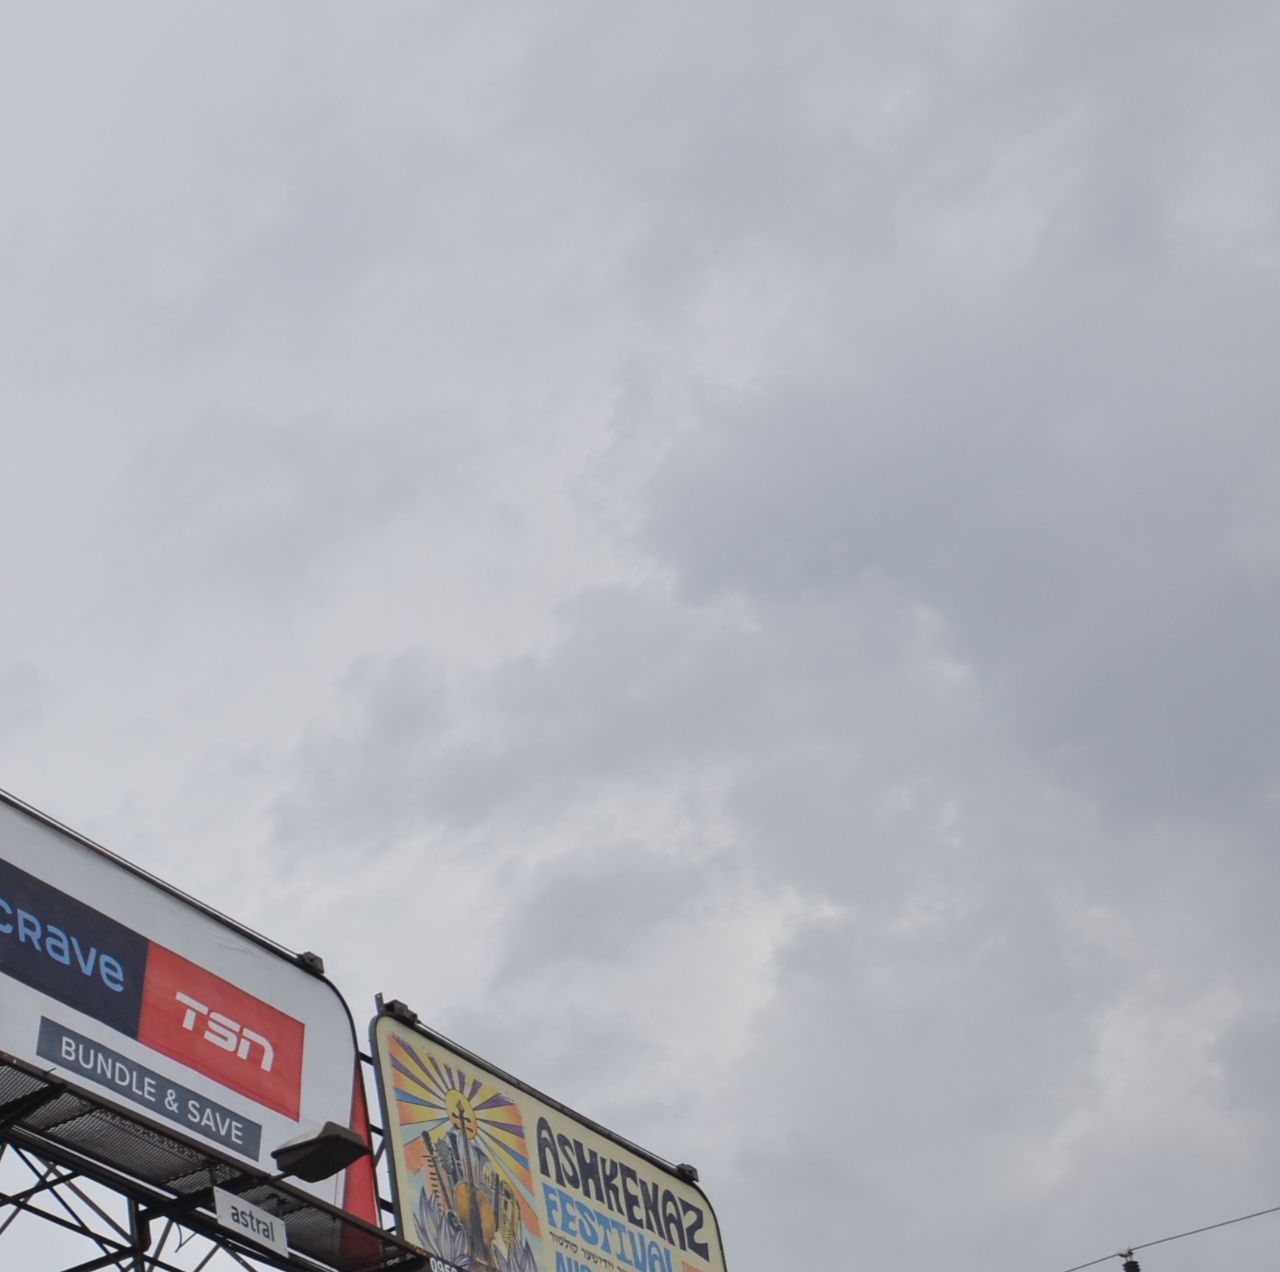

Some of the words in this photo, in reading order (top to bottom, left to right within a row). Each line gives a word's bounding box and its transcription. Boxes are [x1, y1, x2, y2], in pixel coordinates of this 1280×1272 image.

[61, 1036, 156, 1102] BUNDLE
[164, 1089, 179, 1113] &
[187, 1100, 243, 1145] SAVE
[231, 1204, 275, 1243] astral
[536, 1116, 709, 1262] ASHKENAZ
